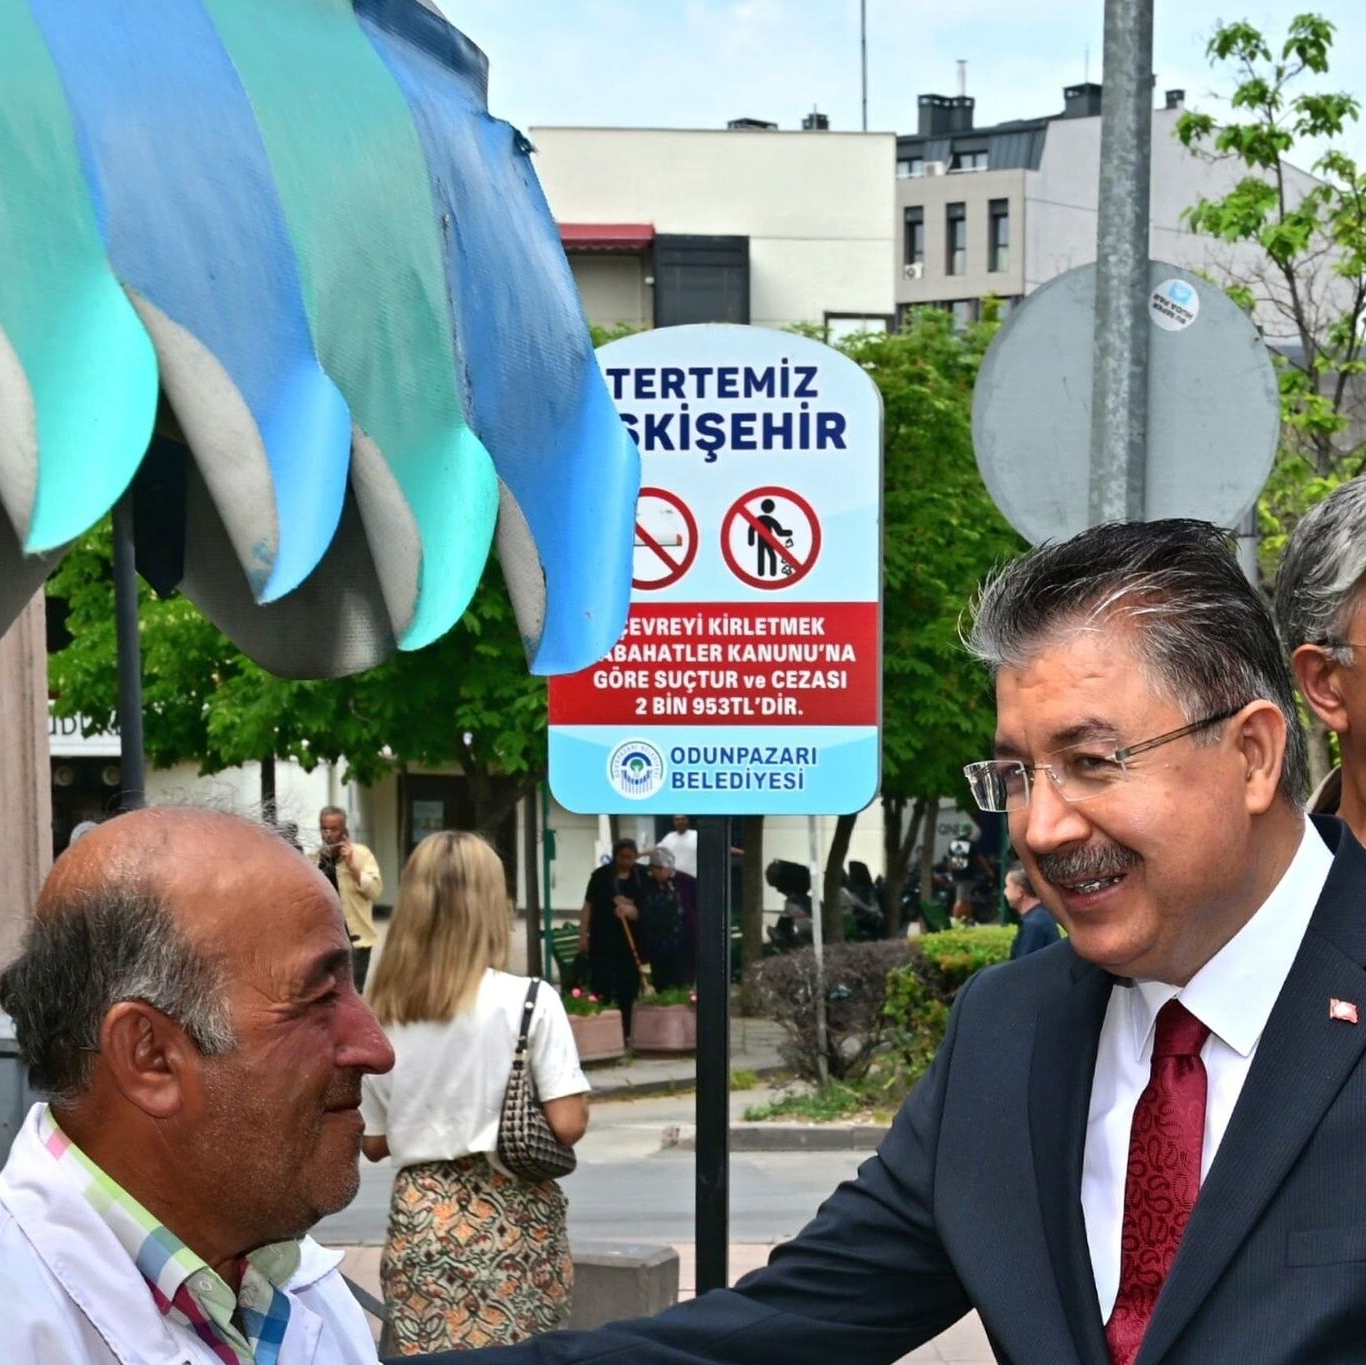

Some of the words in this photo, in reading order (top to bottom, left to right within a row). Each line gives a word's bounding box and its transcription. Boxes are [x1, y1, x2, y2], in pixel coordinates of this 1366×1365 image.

[606, 357, 819, 399] TERTEMİZ
[619, 401, 847, 463] SKİŞEHİR
[622, 613, 703, 640] EVREYİ
[708, 613, 825, 636] KİRLETMEK
[600, 643, 723, 662] BAHATLER
[728, 643, 857, 662] KANUNU'NA
[593, 665, 650, 689] GÖRE
[654, 670, 738, 693] SUÇTUR
[743, 674, 766, 689] ve
[771, 670, 847, 689] CEZASI
[635, 697, 647, 715] 2
[652, 692, 687, 715] BİN
[692, 692, 804, 716] 953TL'DİR.
[670, 747, 817, 765] ODUNPAZARI
[671, 767, 804, 790] BELEDİYESİ
